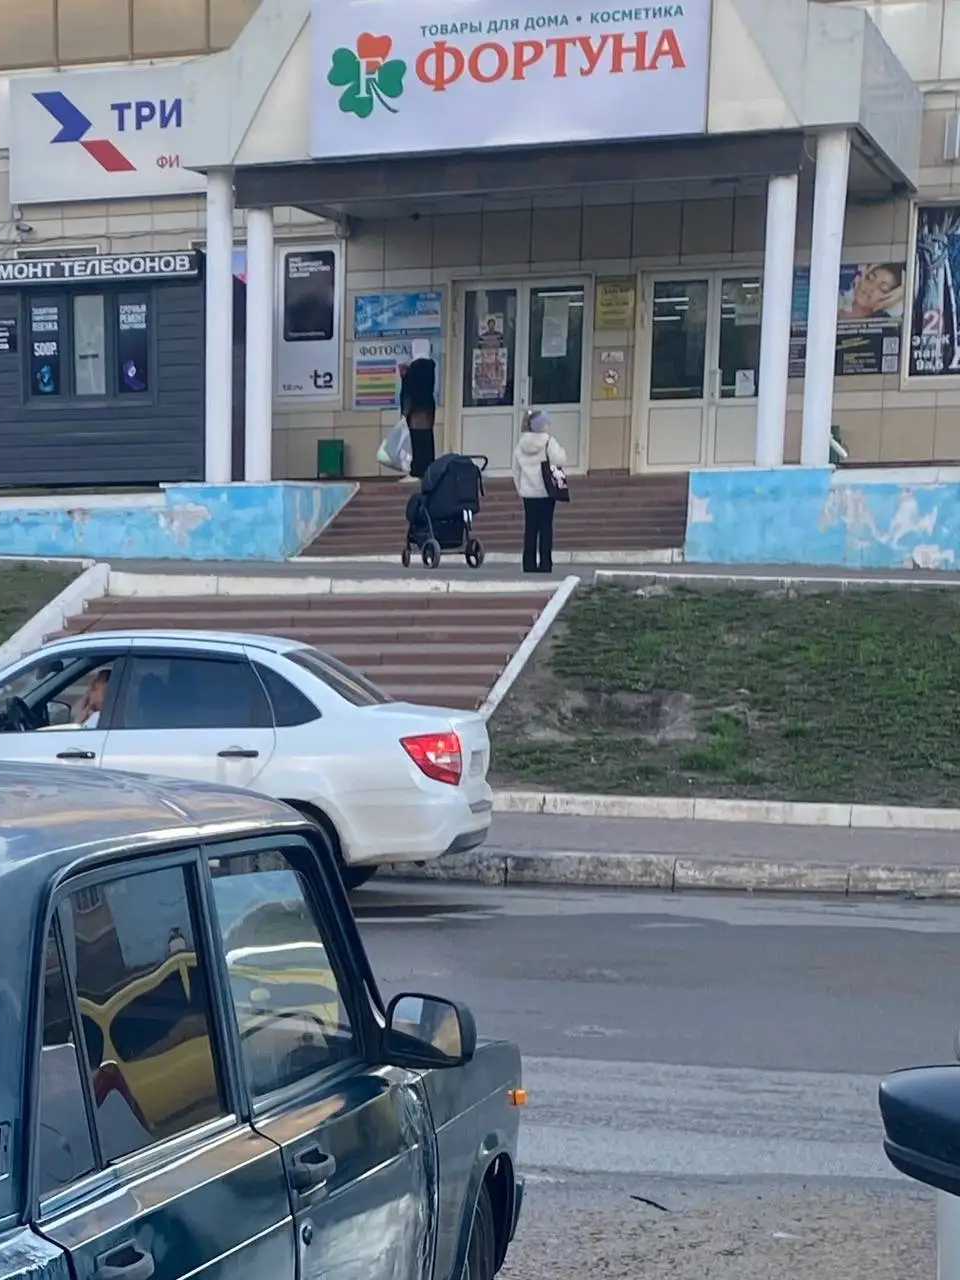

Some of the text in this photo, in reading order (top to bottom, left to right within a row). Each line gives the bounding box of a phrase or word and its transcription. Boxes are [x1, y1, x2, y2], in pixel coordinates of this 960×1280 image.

[420, 5, 685, 37] ТОВАРЫ ДЛЯ ДОМА КОСМЕТИКА
[415, 29, 687, 92] ФОРТУНА
[110, 98, 182, 132] ТРИ
[60, 255, 191, 278] ТЕЛЕФОНОВ
[313, 369, 334, 389] t2
